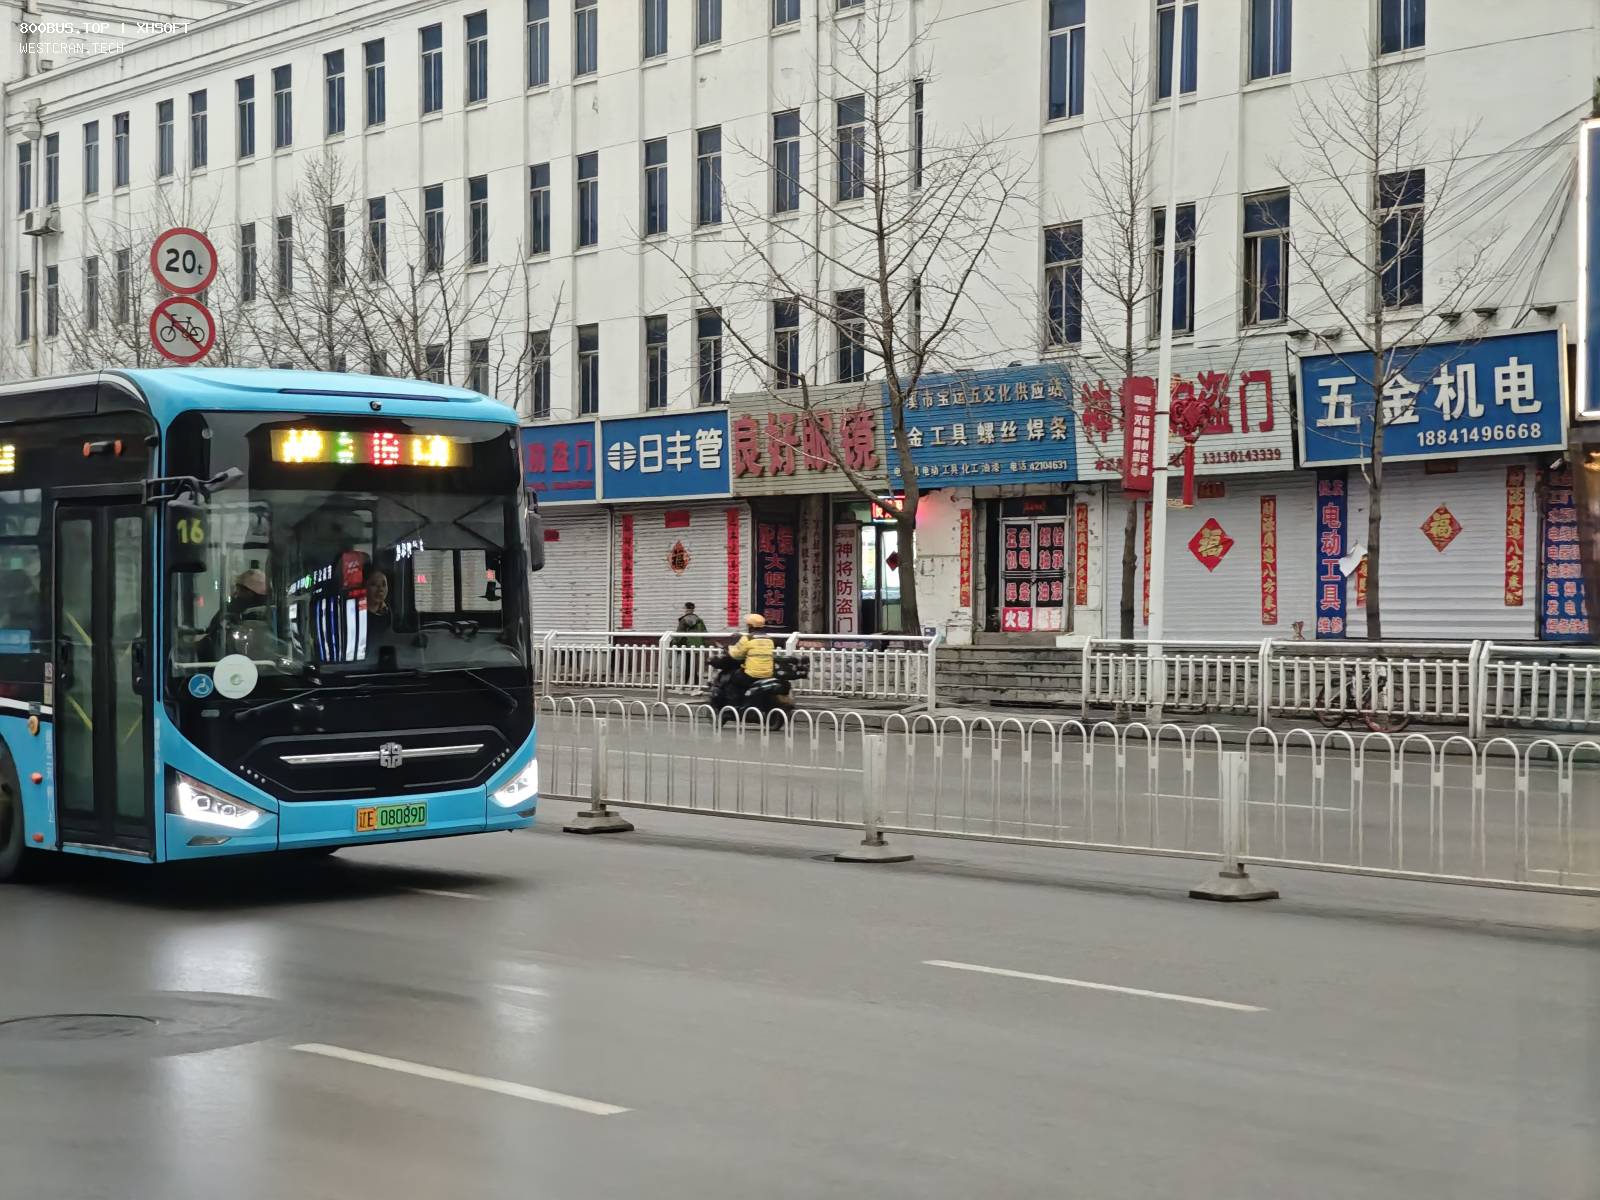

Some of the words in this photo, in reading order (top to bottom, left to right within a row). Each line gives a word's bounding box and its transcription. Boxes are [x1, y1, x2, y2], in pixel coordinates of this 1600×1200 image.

[1316, 356, 1542, 427] 五金机电
[640, 428, 723, 473] 日丰管
[1417, 423, 1542, 447] 18841496668
[176, 518, 205, 544] 16
[1320, 502, 1342, 611] 电动工具
[835, 542, 853, 633] 神将防盗门
[380, 806, 425, 826] 08089D
